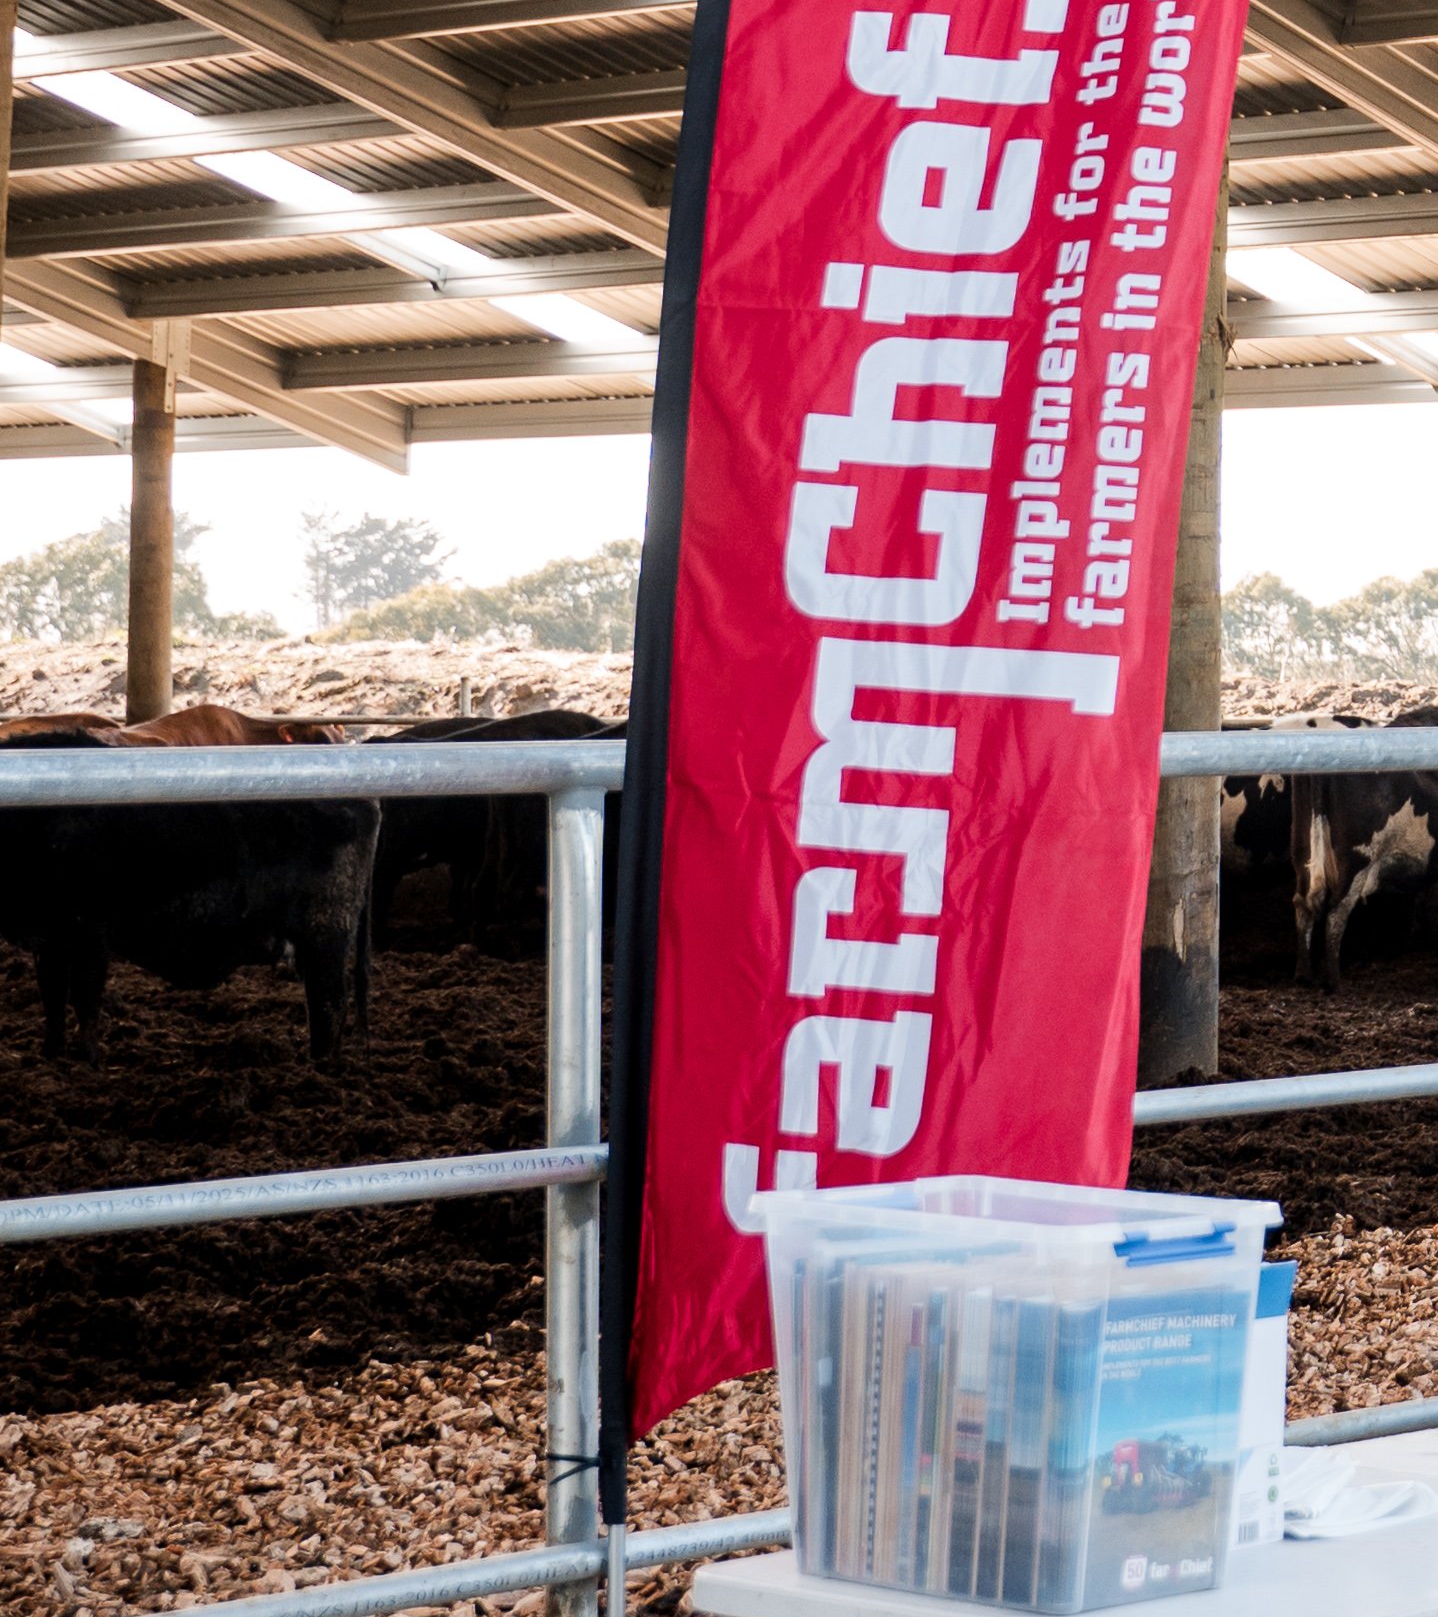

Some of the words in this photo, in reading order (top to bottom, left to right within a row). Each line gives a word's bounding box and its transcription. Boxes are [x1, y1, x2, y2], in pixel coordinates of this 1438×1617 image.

[1076, 2, 1130, 106] the
[1053, 121, 1110, 220] for
[1110, 145, 1178, 252] the
[1100, 272, 1163, 331] in
[996, 239, 1092, 626] Implements
[1065, 351, 1152, 630] farmers
[1103, 1336, 1152, 1353] PRODUCT
[1153, 1333, 1192, 1349] RANGE
[1105, 1316, 1165, 1335] FARMCHIEF
[1167, 1313, 1238, 1329] MACHINERY
